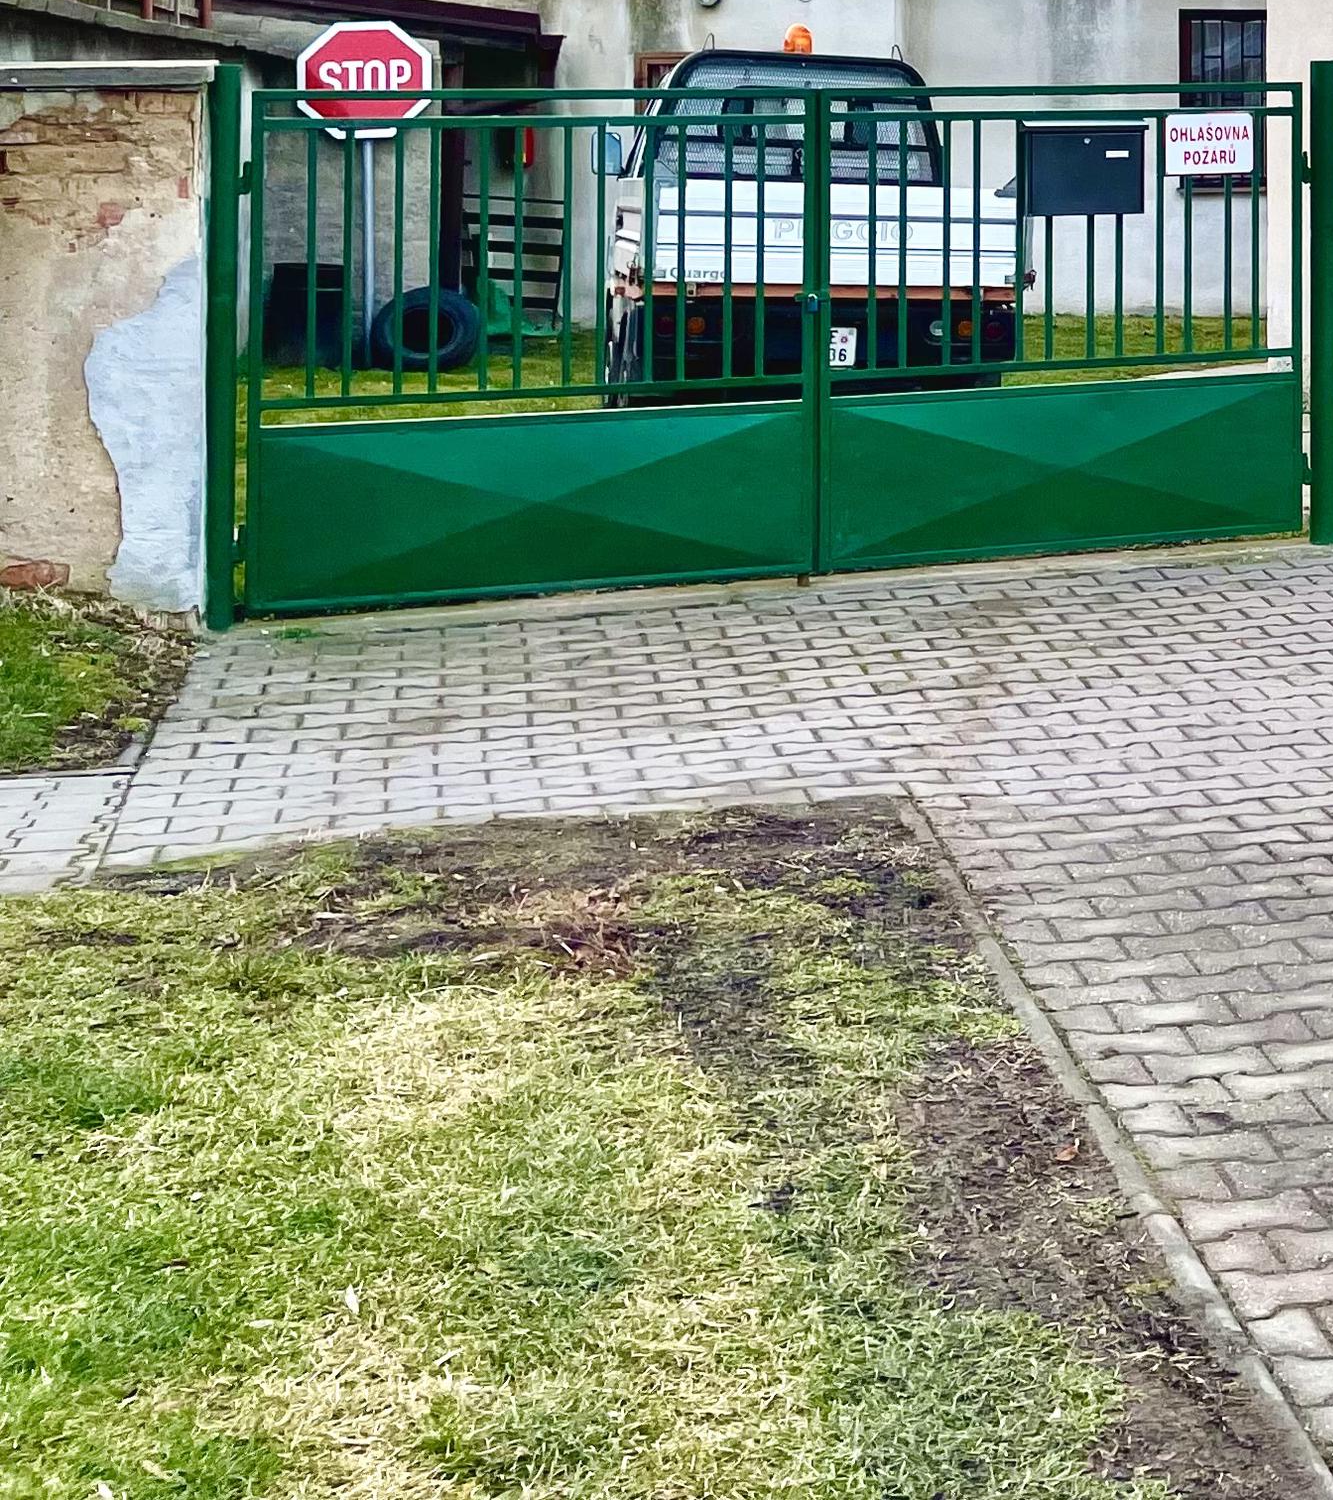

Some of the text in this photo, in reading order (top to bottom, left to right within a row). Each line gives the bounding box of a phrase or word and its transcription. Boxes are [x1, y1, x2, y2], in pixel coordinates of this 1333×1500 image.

[318, 58, 412, 91] STOP
[1169, 122, 1250, 142] OHLAŠOVNA
[1183, 143, 1236, 165] POŽÁRŮ
[772, 218, 914, 242] PIGGIO
